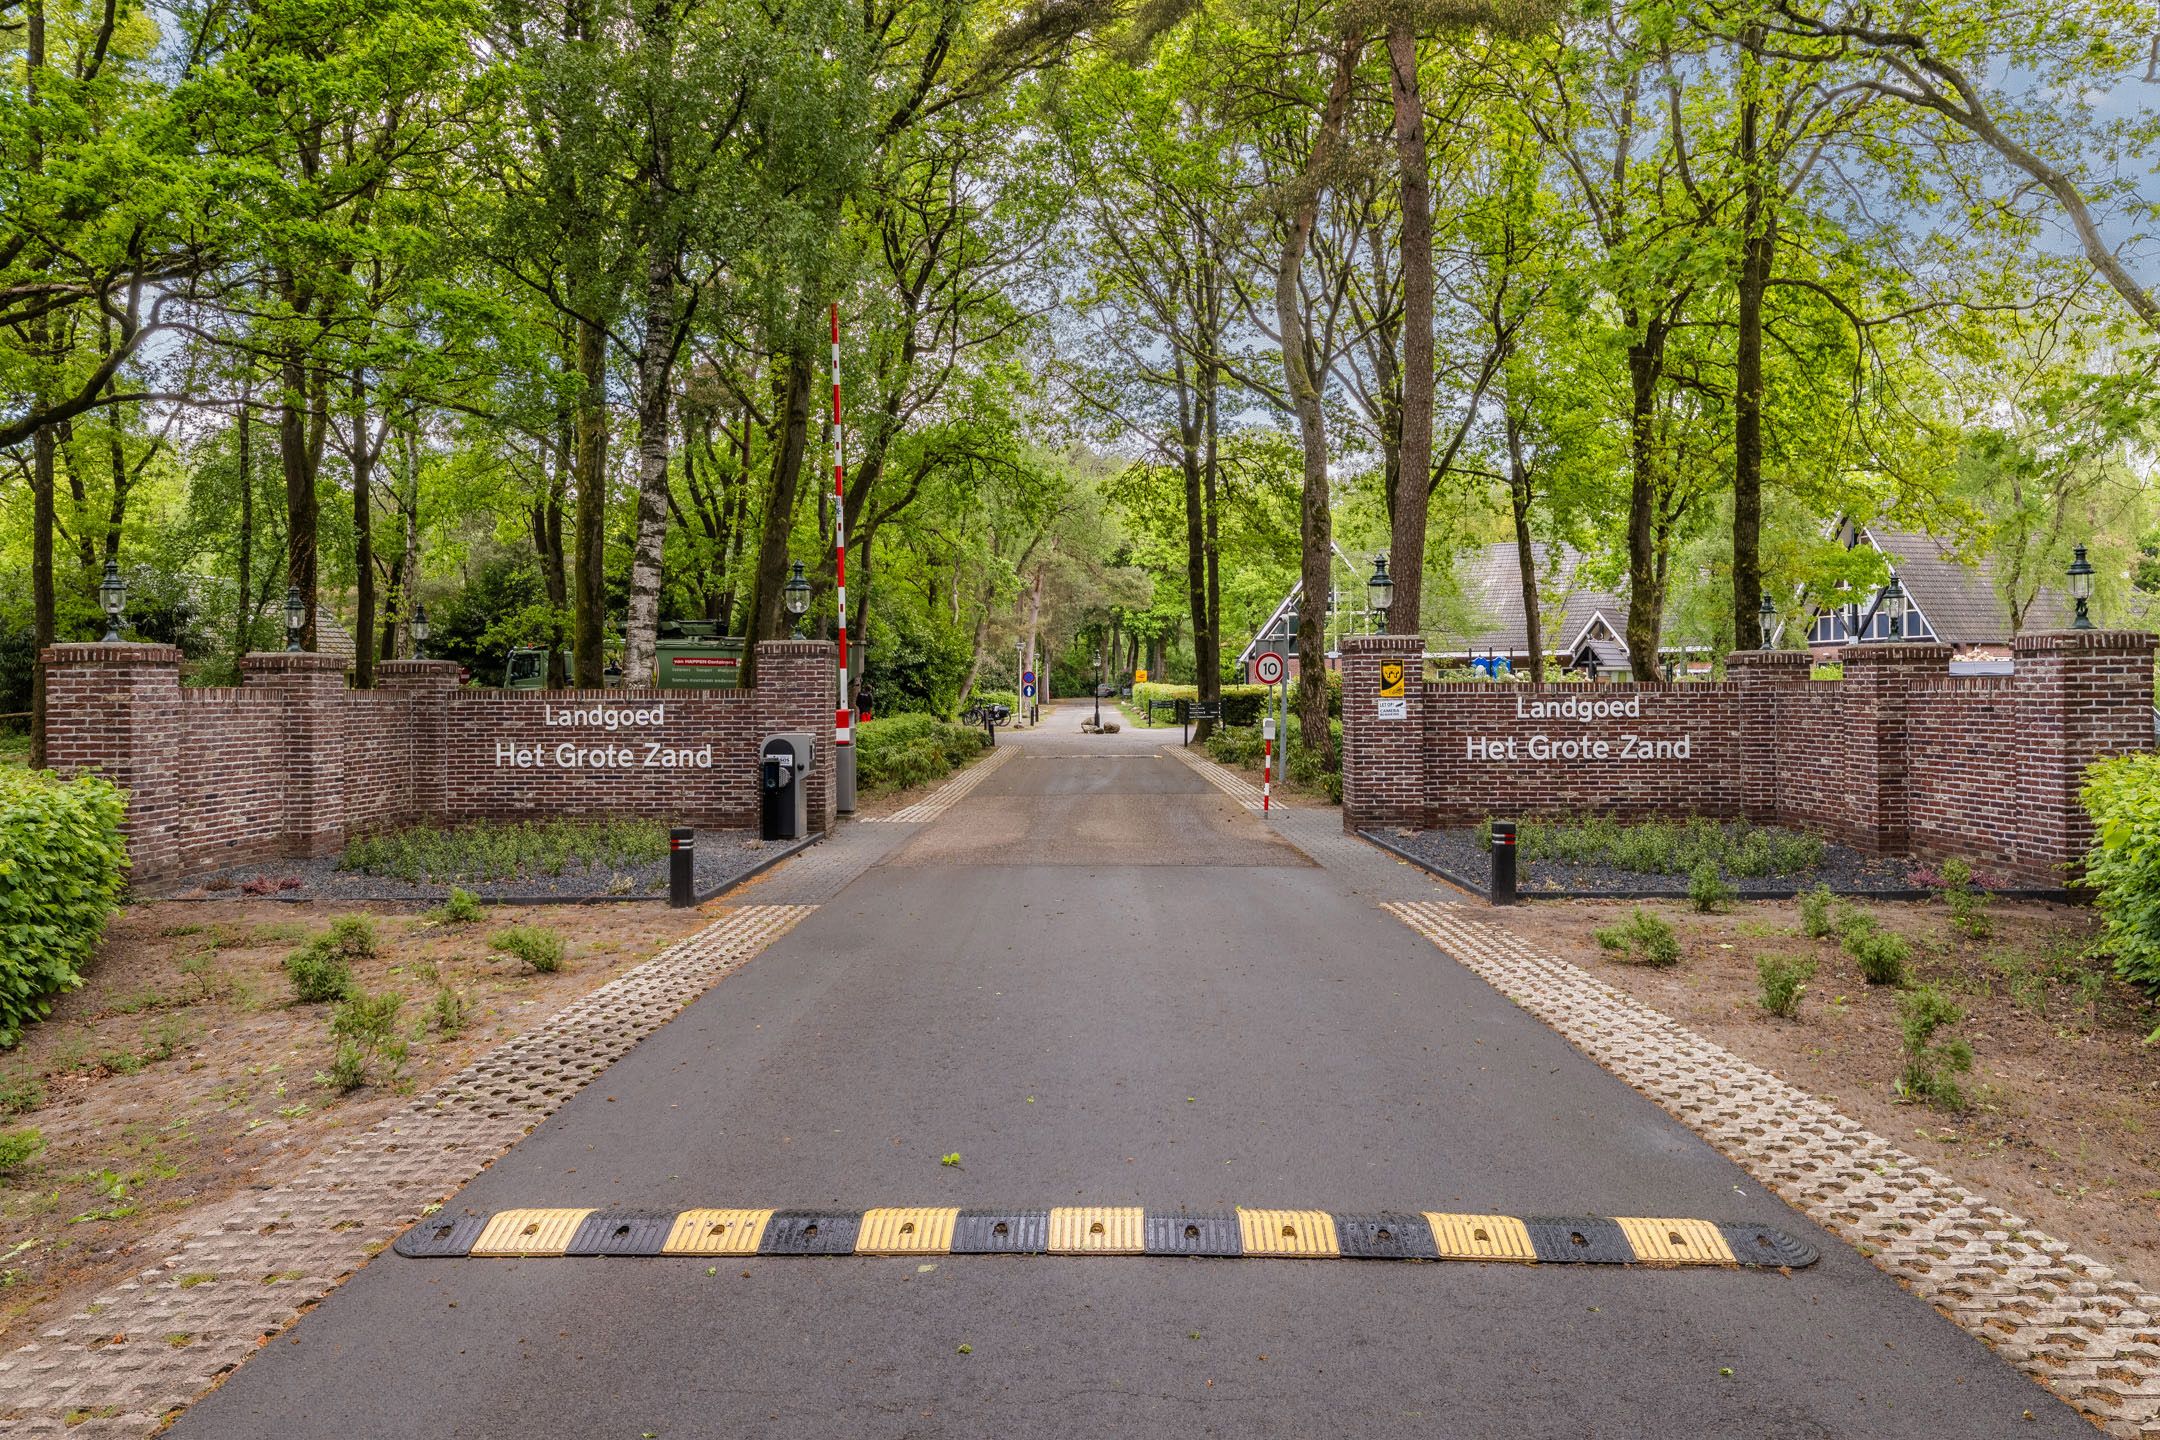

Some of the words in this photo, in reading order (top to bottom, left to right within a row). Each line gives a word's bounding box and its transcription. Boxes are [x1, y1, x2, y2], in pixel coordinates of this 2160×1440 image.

[1263, 662, 1278, 675] 10
[545, 703, 665, 731] Landgoed
[1517, 695, 1640, 723] Landgoed
[496, 742, 545, 767] Het
[555, 742, 633, 768] Grote
[642, 742, 712, 768] Zand
[1466, 734, 1518, 760] Het
[1527, 733, 1610, 760] Grote
[1620, 734, 1690, 759] Zand
